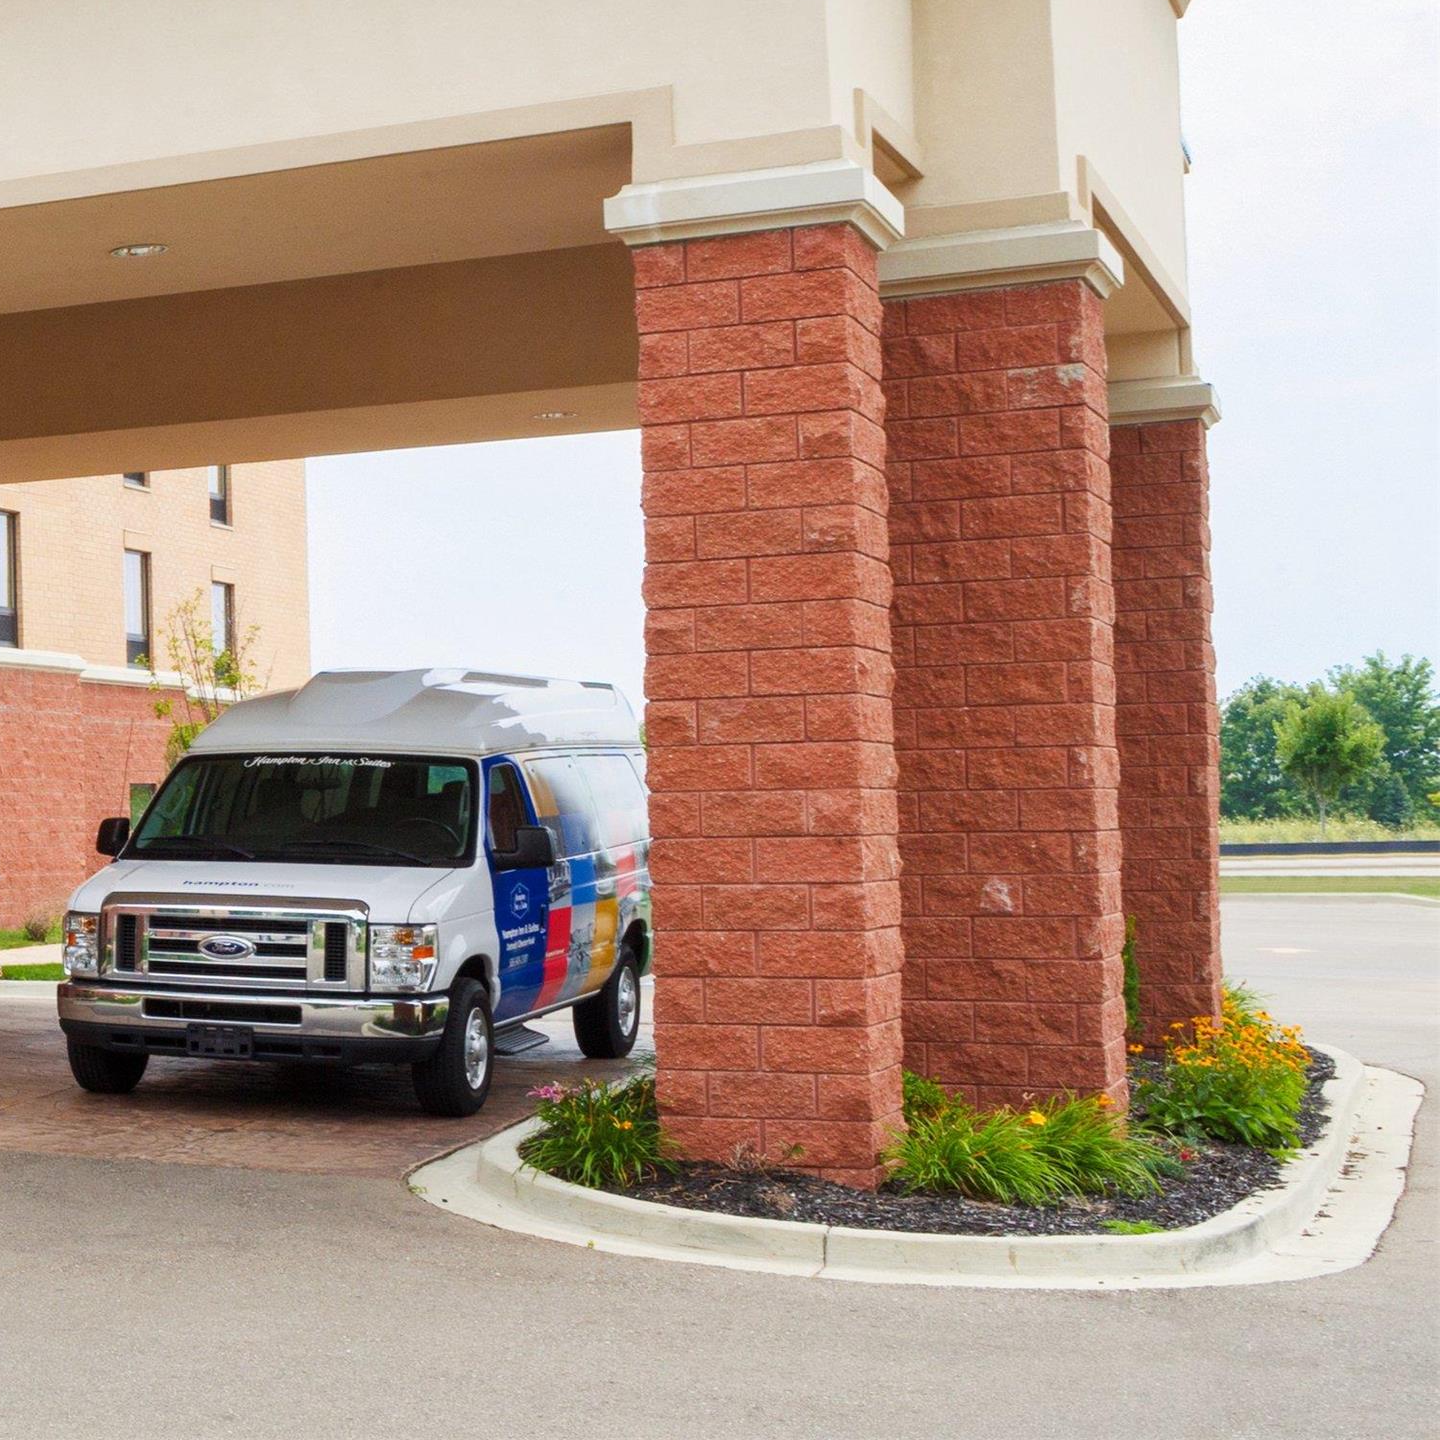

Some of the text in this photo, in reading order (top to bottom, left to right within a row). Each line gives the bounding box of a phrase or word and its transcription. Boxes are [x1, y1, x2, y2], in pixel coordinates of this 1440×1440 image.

[244, 755, 310, 767] Hampton
[309, 755, 340, 766] Inn
[354, 757, 392, 768] Suites
